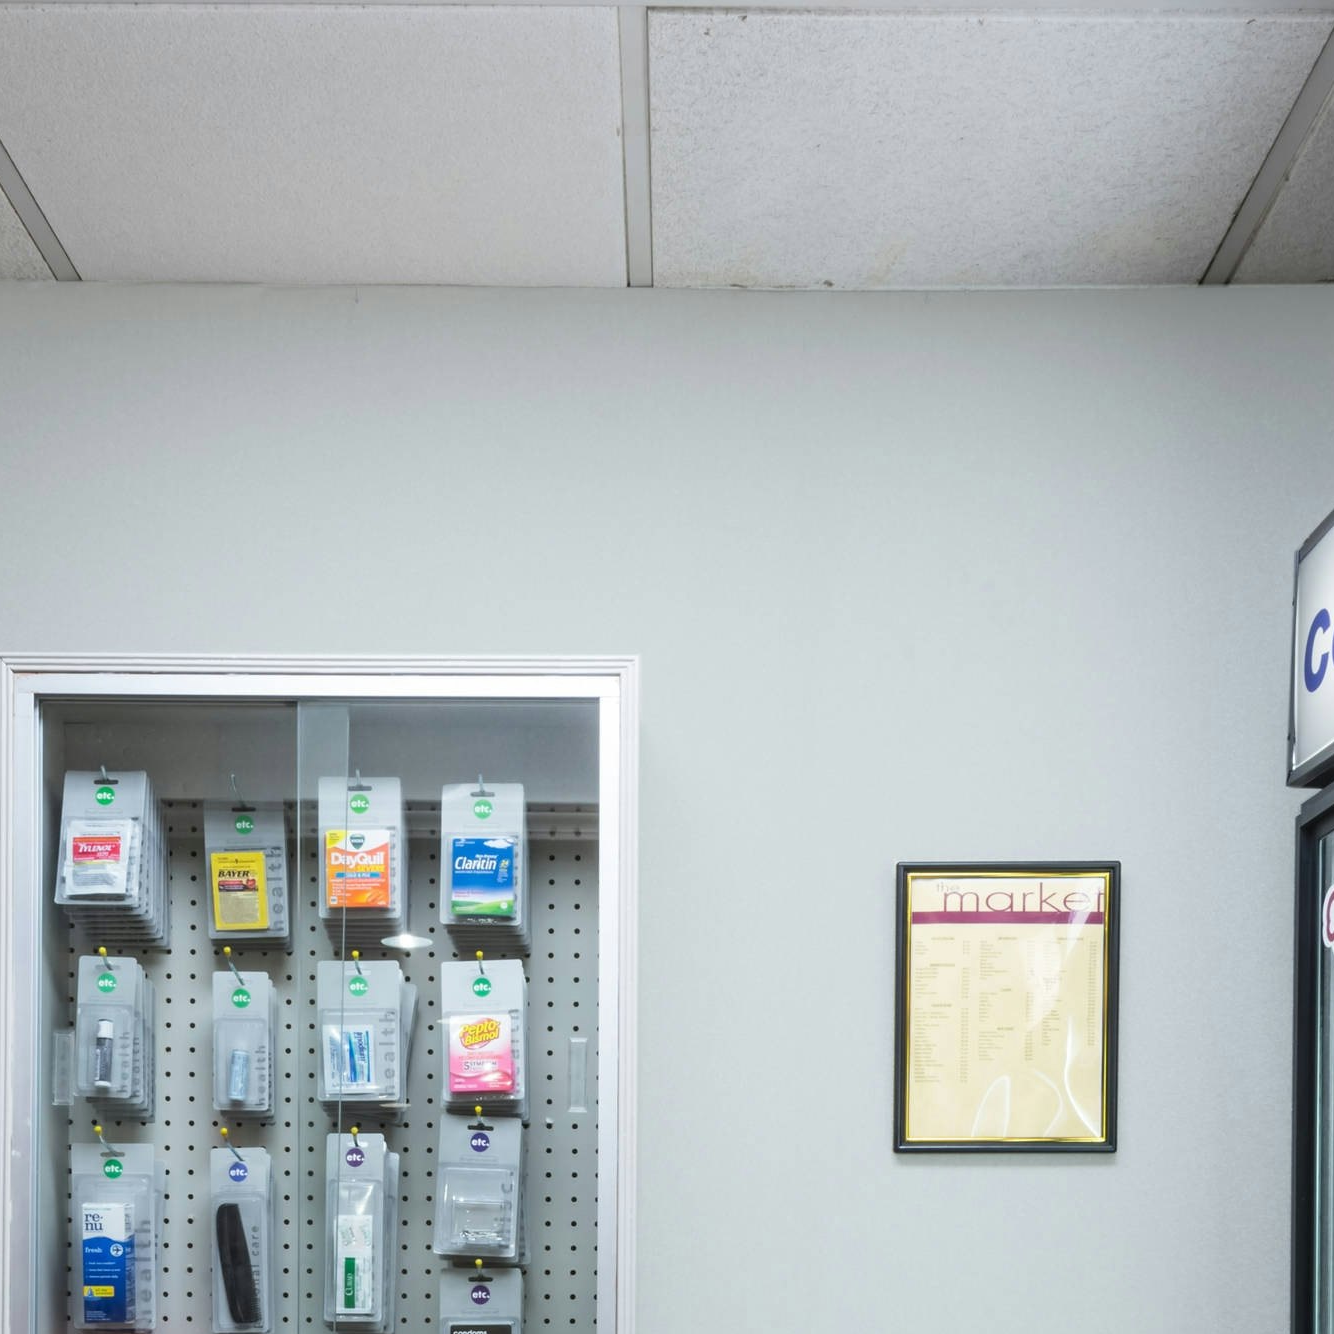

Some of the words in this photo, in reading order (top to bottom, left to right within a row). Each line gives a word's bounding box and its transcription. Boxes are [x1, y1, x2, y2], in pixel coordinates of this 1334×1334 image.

[96, 791, 115, 800] etc.
[350, 799, 369, 808] etc.
[474, 805, 493, 814] etc.
[235, 820, 254, 829] etc.
[330, 852, 385, 869] DayQuil
[454, 856, 497, 870] Claritin
[217, 869, 251, 878] BAYER
[943, 882, 1105, 912] market
[98, 979, 117, 988] etc.
[349, 982, 368, 991] etc.
[473, 983, 492, 991] etc.
[232, 994, 251, 1003] etc.
[466, 1028, 499, 1047] Bismol
[120, 1031, 131, 1094] health
[255, 1045, 266, 1107] health
[471, 1138, 490, 1146] etc.
[346, 1153, 365, 1162] etc.
[104, 1164, 123, 1173] etc.
[229, 1168, 248, 1177] etc.
[471, 1291, 490, 1299] etc.
